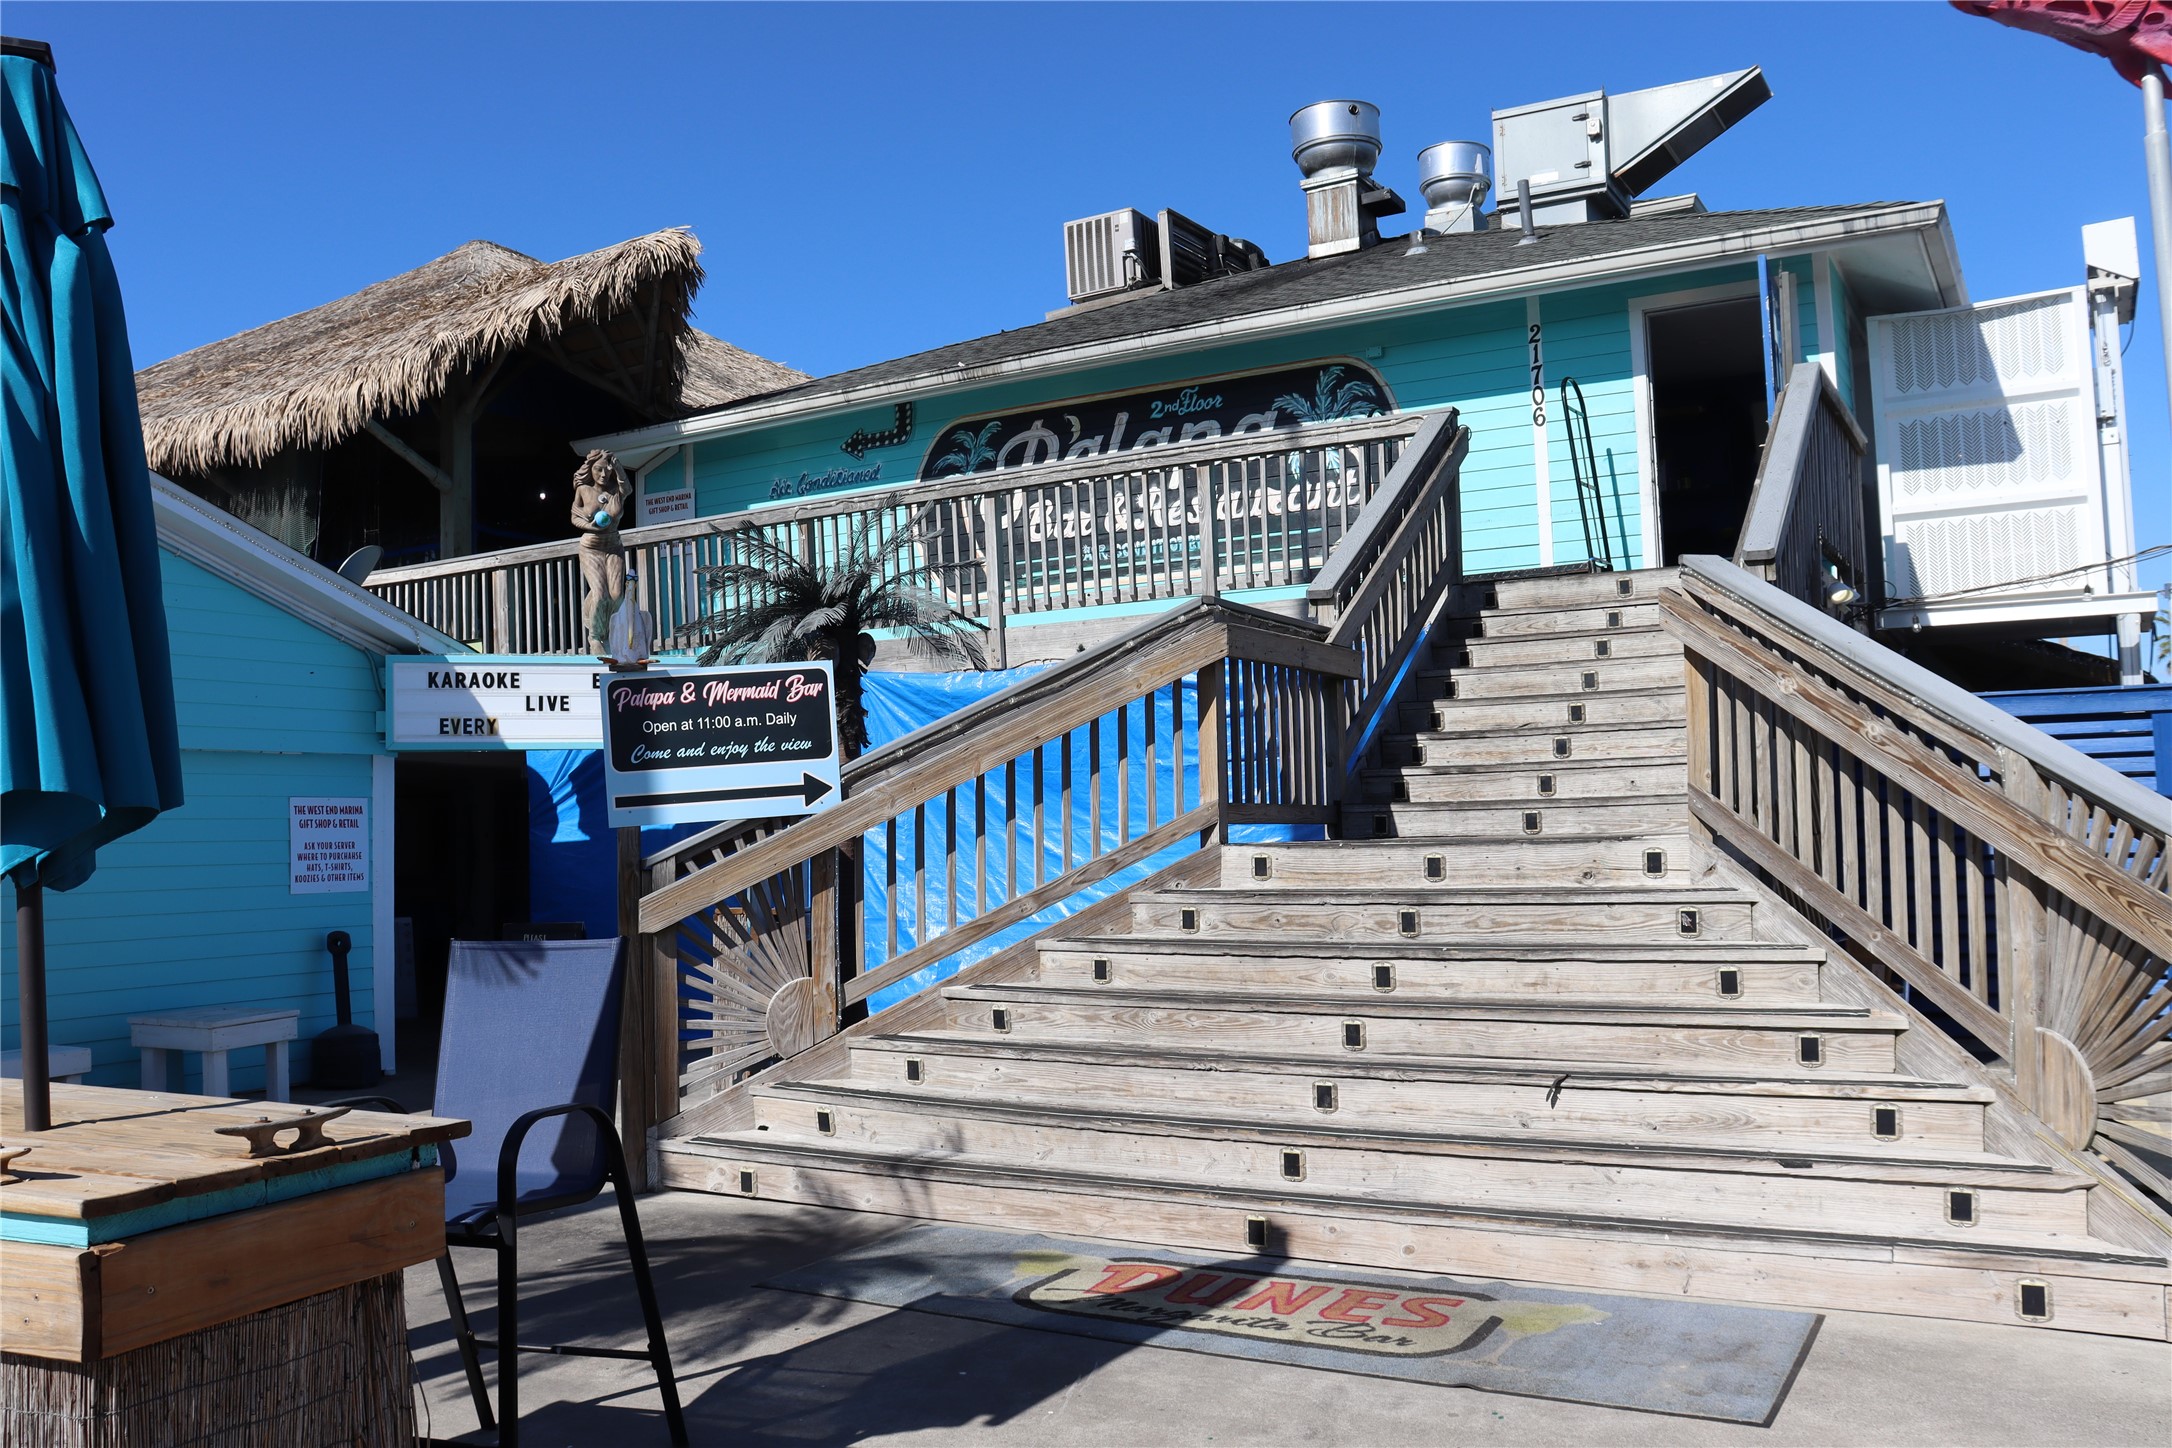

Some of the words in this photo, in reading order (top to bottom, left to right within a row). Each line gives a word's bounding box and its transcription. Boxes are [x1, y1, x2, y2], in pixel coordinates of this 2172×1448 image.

[1528, 324, 1546, 427] 21706
[1150, 400, 1179, 419] 2nd
[1178, 386, 1223, 415] Floor
[769, 478, 793, 499] Air
[796, 463, 882, 496] Conditioned
[428, 672, 520, 689] KARAOKE
[613, 687, 676, 713] Palapa
[680, 682, 696, 704] &
[702, 678, 783, 707] Mermaid
[785, 674, 824, 702] Bar
[526, 696, 570, 711] LIVE
[439, 718, 497, 735] EVERY
[642, 719, 677, 735] Open
[681, 719, 694, 731] at
[697, 716, 731, 730] 11:00
[735, 716, 762, 728] a.m.
[766, 712, 797, 727] Daily
[630, 744, 672, 764] Come
[677, 742, 705, 758] and
[710, 742, 749, 760] enjoy
[754, 735, 776, 753] the
[780, 739, 812, 751] view
[293, 805, 306, 815] THE
[307, 805, 324, 815] WEST
[325, 805, 339, 815] END
[339, 805, 363, 815] MARINA
[298, 819, 313, 829] GIFT
[314, 819, 332, 829] SHOP
[332, 819, 338, 829] &
[338, 819, 360, 829] RETAIL
[304, 842, 316, 850] ASK
[317, 841, 333, 850] YOUR
[334, 841, 356, 850] SERVER
[297, 852, 319, 861] WHERE
[320, 852, 328, 861] TO
[329, 851, 363, 861] PURCHAHSE
[306, 863, 324, 872] HATS,
[325, 862, 353, 871] T-SHIRTS,
[294, 874, 320, 883] KOOZIES
[321, 873, 326, 882] &
[327, 873, 346, 882] OTHER
[347, 872, 365, 881] ITEMS
[1084, 1264, 1465, 1328] DUNES
[1078, 1294, 1294, 1333] Margarita
[1304, 1319, 1417, 1347] Bar
